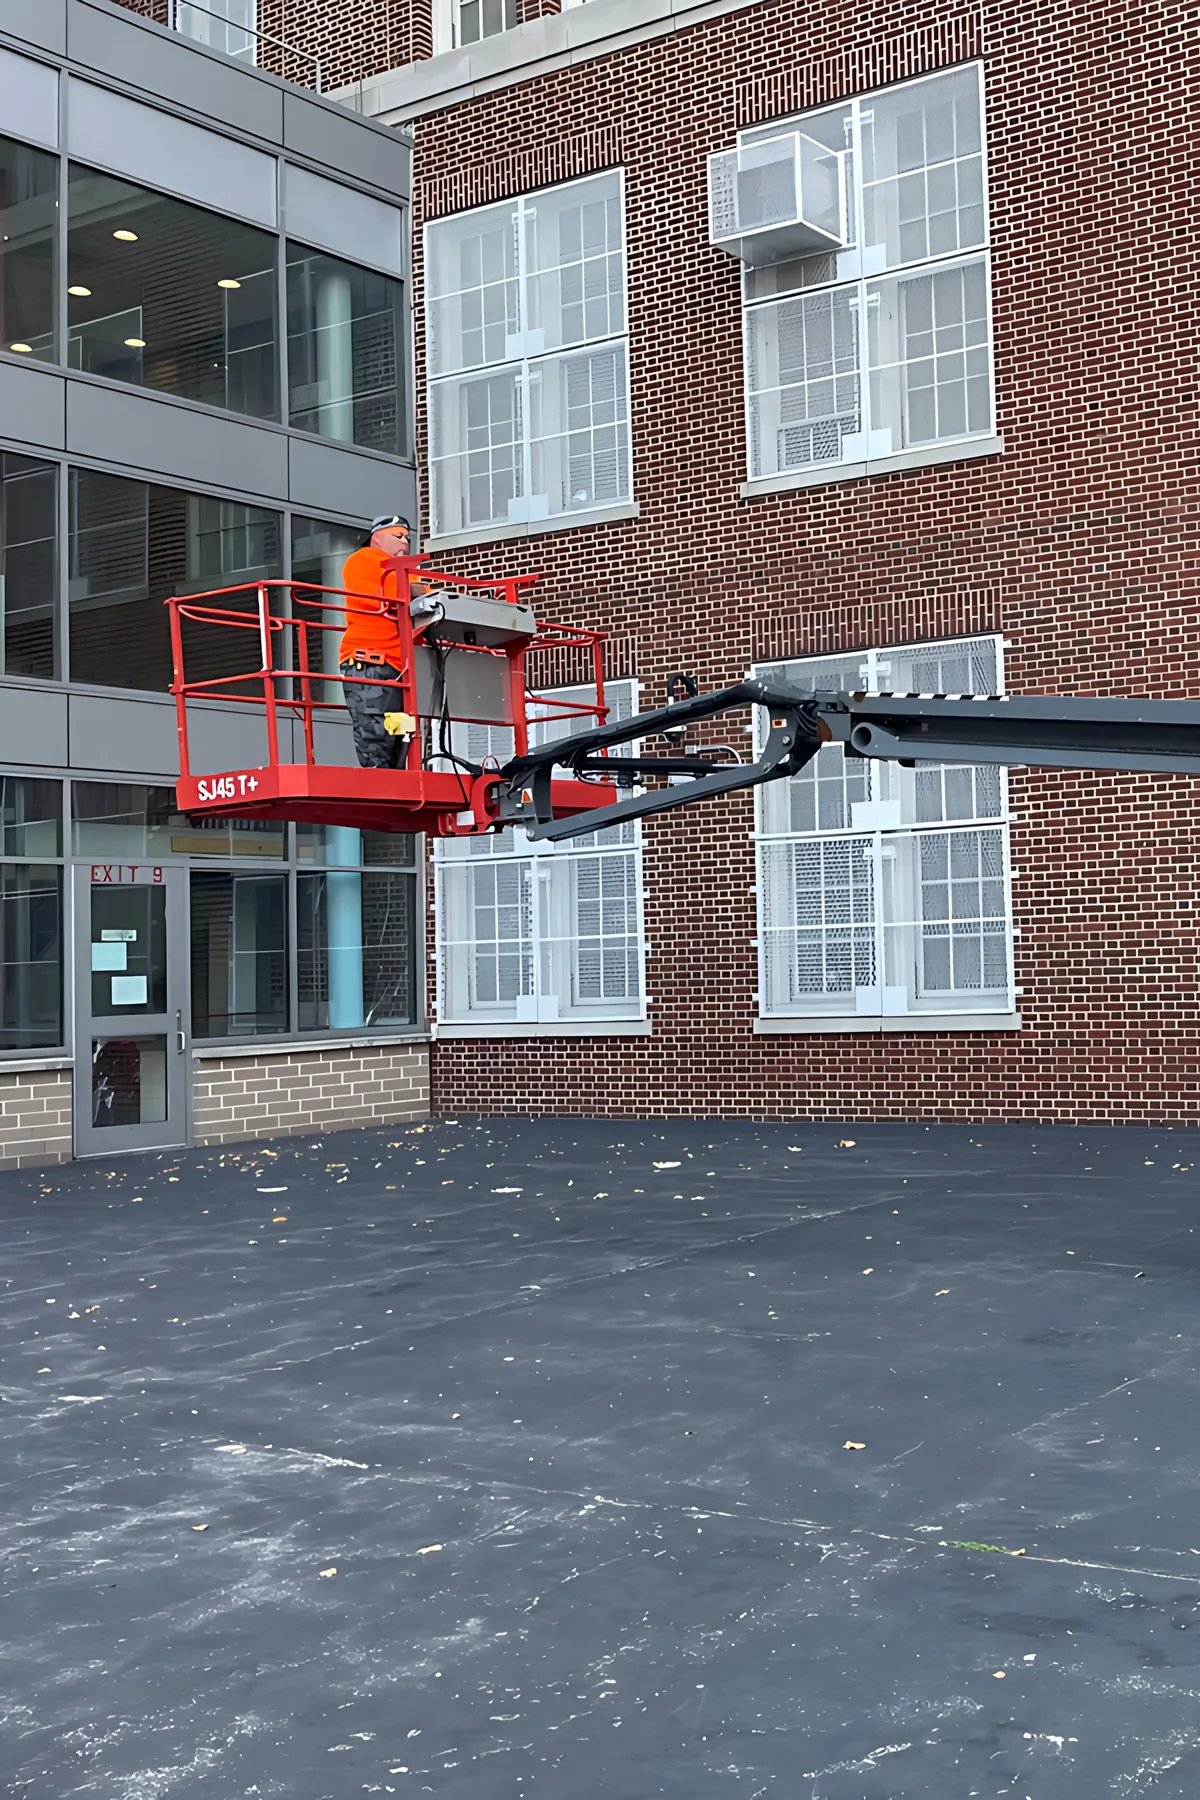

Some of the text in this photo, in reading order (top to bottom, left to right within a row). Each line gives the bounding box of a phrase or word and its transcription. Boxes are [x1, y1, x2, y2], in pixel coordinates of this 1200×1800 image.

[197, 774, 260, 801] SJ45 T+
[91, 865, 163, 883] EXIT 9
